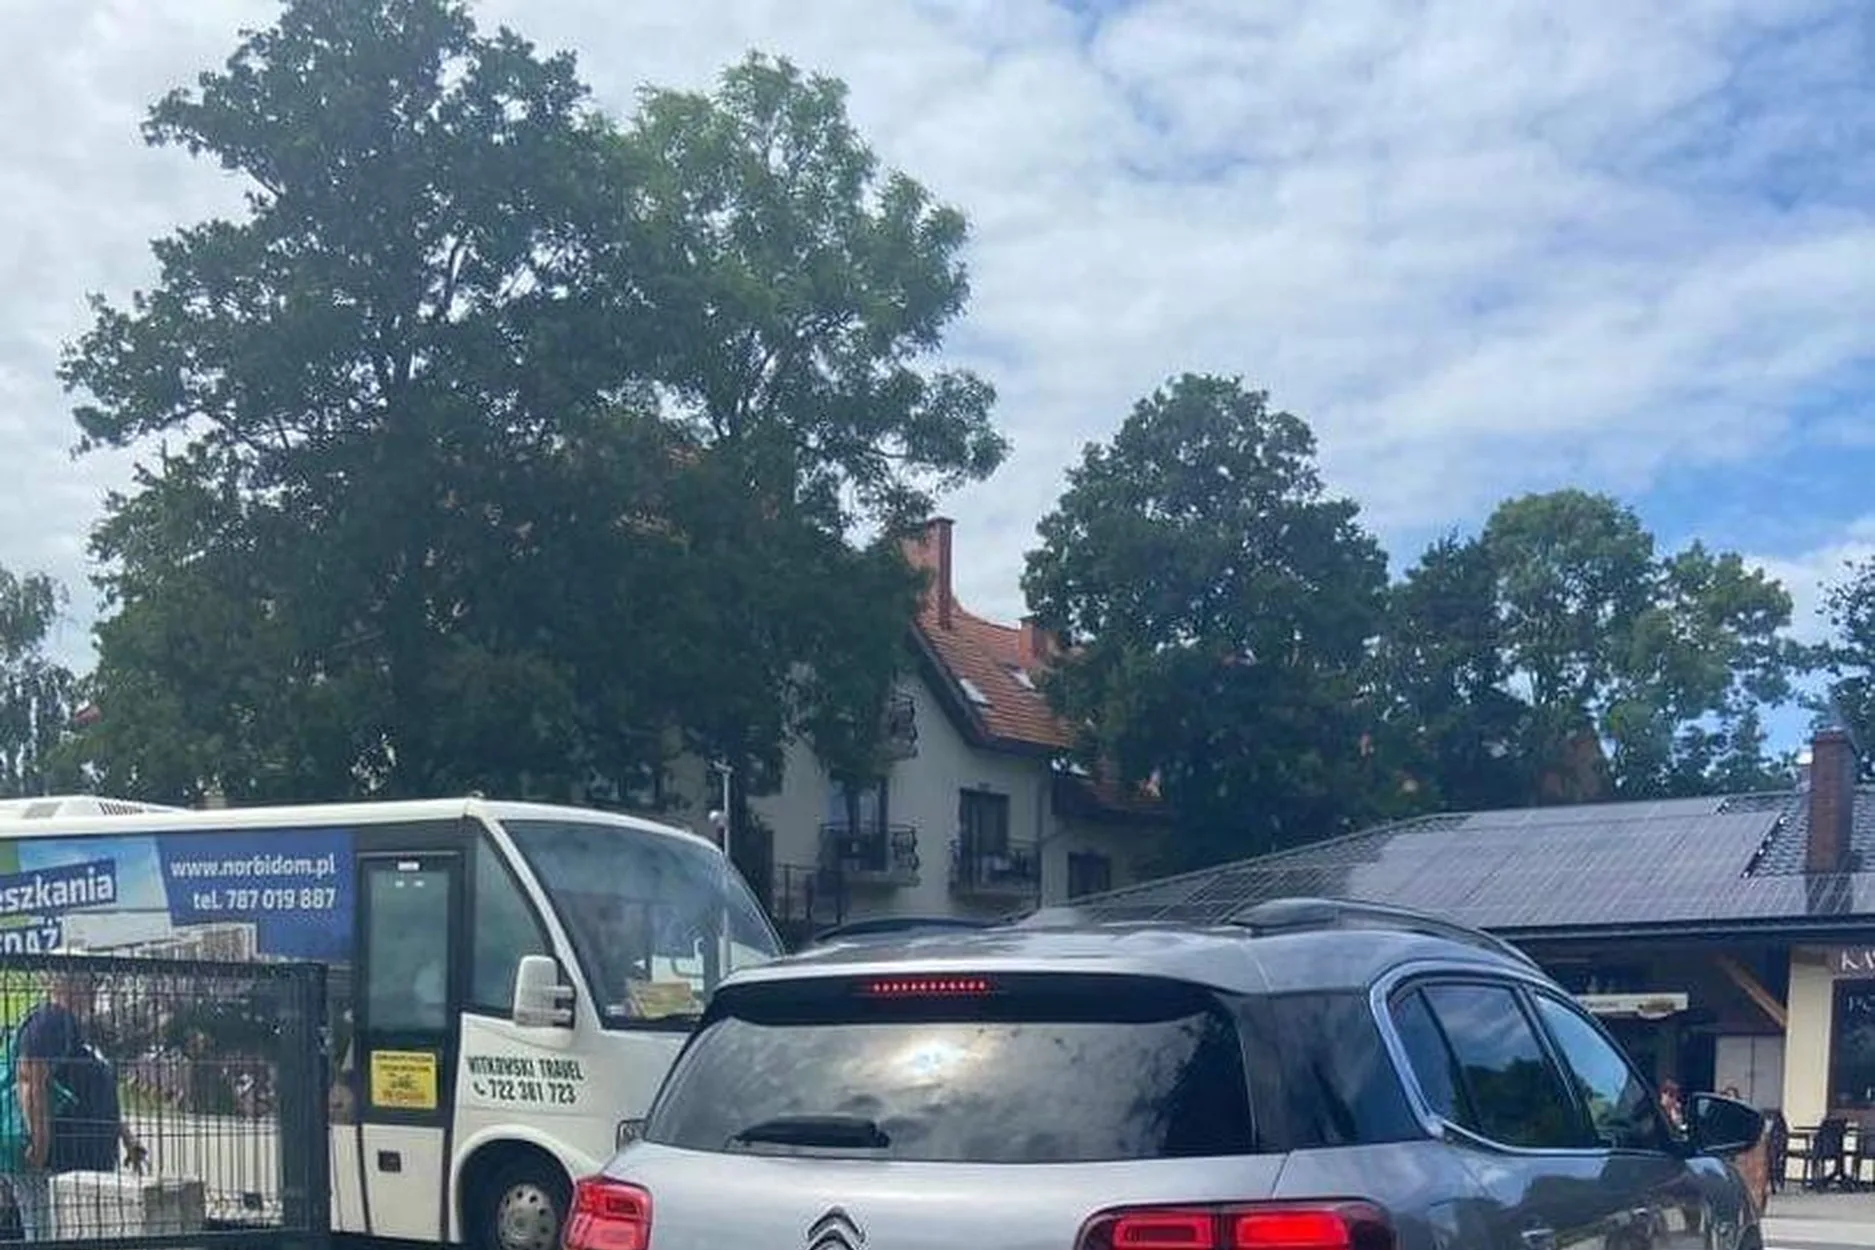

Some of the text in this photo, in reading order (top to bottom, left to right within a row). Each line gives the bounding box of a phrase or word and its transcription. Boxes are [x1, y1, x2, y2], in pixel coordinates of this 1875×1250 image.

[170, 853, 335, 879] www.norbidom.pl
[0, 866, 114, 912] szkania
[193, 887, 336, 910] tel. 787 019 887
[539, 1059, 584, 1080] TRAVEL
[488, 1079, 516, 1100] 722
[548, 1083, 576, 1104] 723
